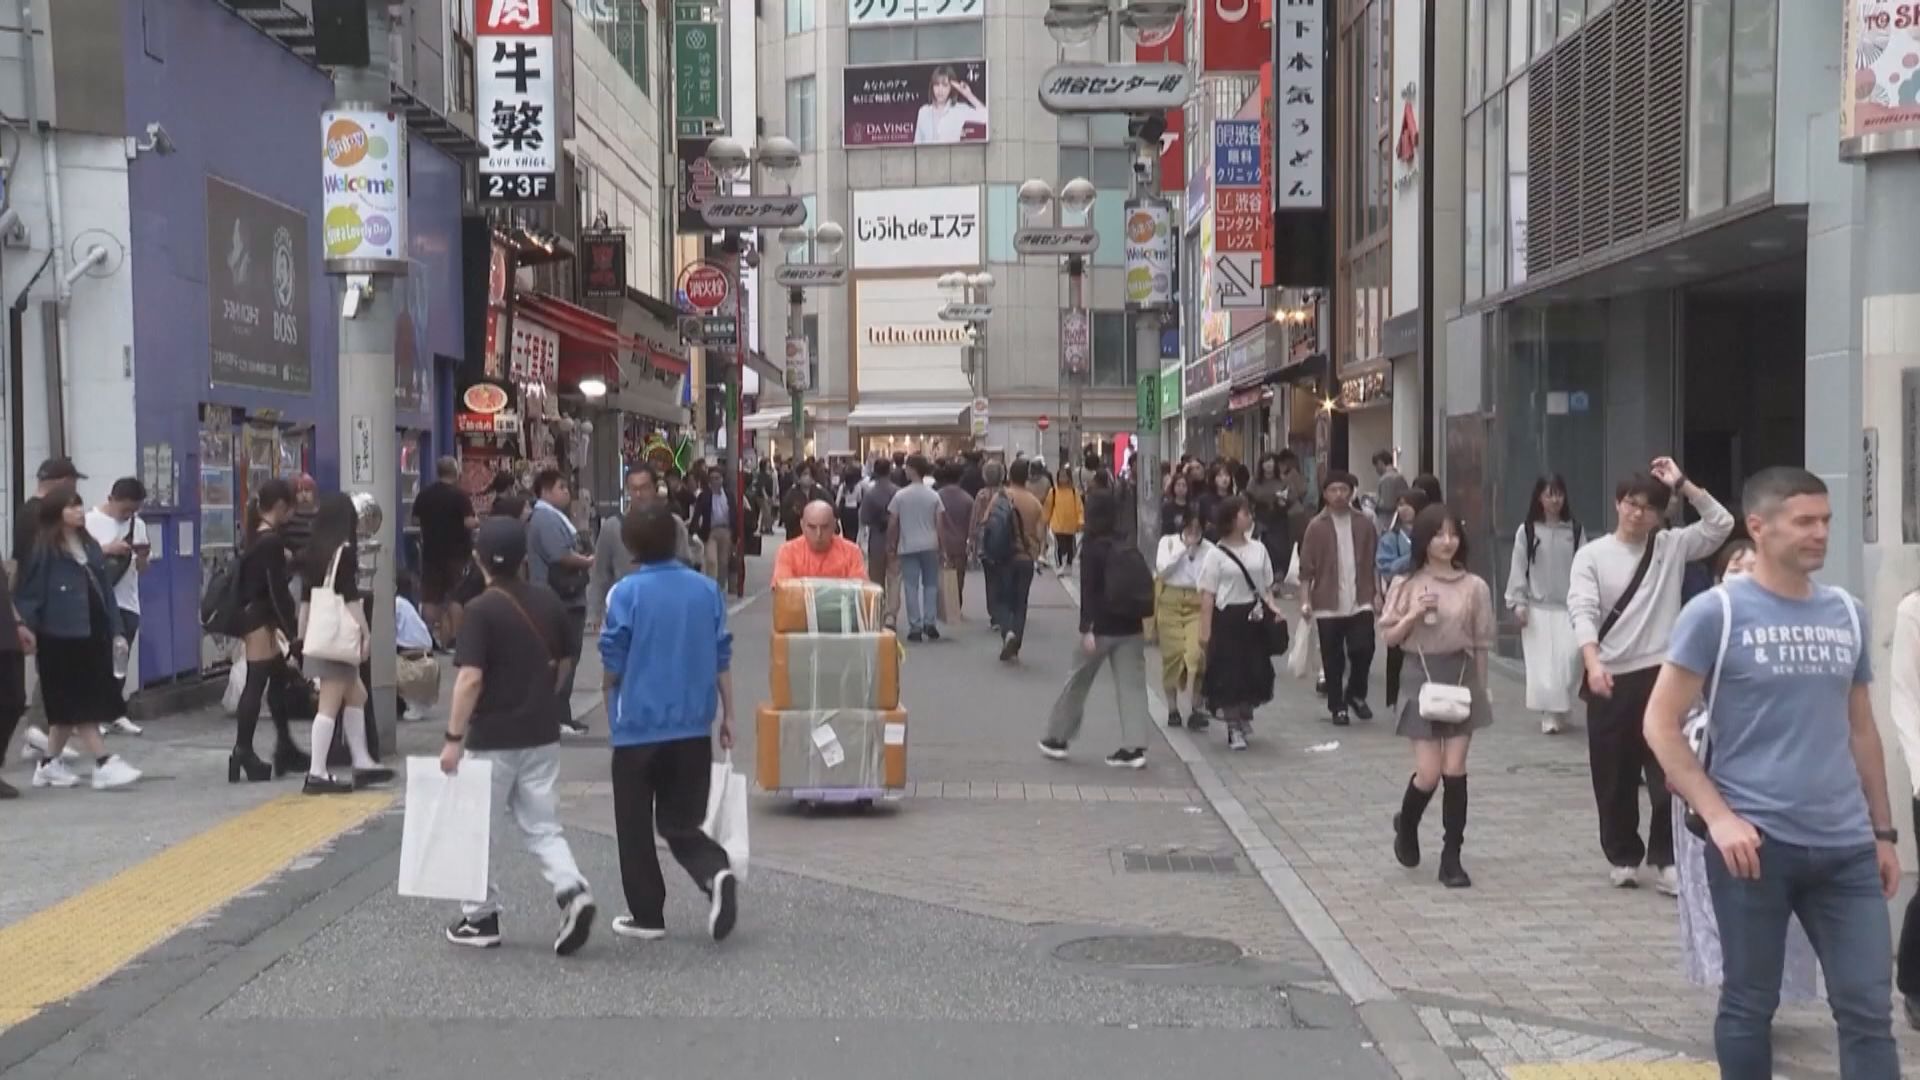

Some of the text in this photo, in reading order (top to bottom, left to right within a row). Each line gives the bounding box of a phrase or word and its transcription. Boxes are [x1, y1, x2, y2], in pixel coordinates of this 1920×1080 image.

[1050, 73, 1183, 95] 渋谷センター街
[492, 41, 543, 151] 牛繁
[1286, 0, 1314, 197] 下本気うどん
[866, 122, 914, 135] DA VINCI
[324, 172, 395, 195] Welcome
[1217, 167, 1262, 182] クリニック
[1216, 215, 1262, 231] コンタクト
[1227, 233, 1254, 249] レンズ
[273, 311, 298, 345] BOSS
[1755, 647, 1769, 664] &
[1779, 644, 1830, 662] FITCH
